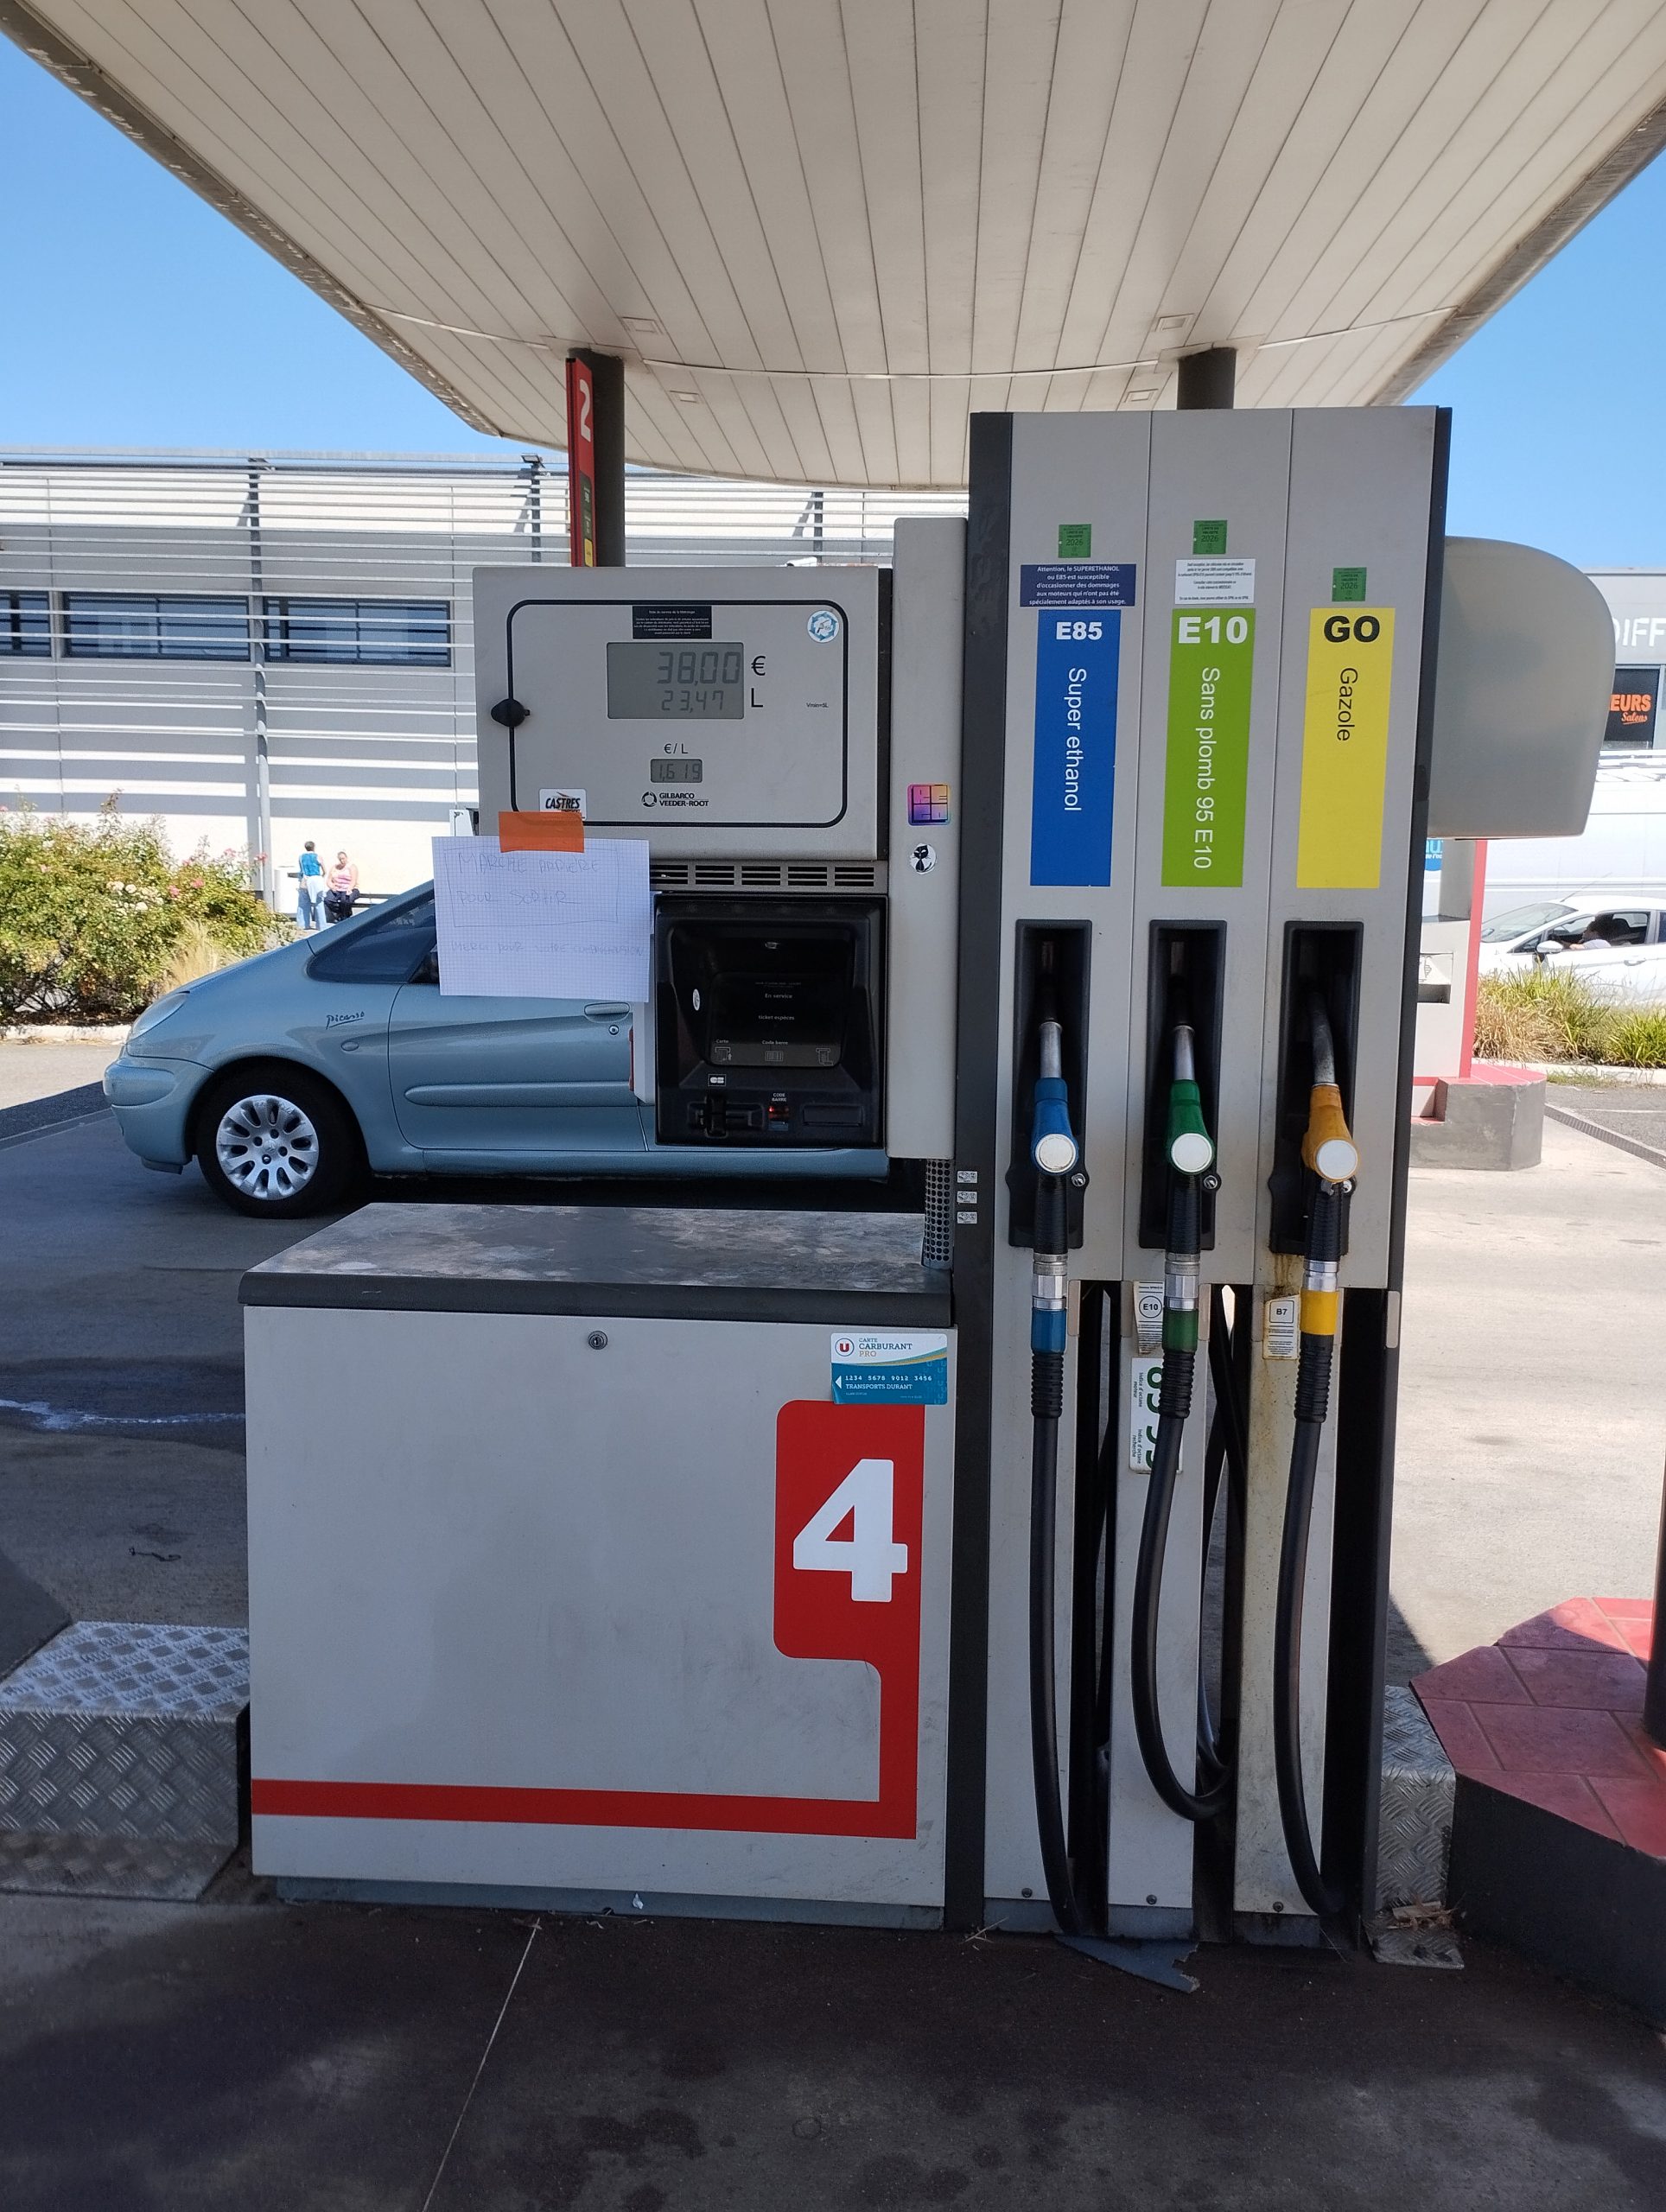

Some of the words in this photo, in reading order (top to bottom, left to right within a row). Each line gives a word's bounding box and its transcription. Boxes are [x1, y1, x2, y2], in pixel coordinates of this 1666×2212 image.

[580, 378, 591, 442] 2
[1055, 621, 1103, 641] E85
[1177, 616, 1249, 645] E10
[1323, 614, 1381, 644] GO
[751, 687, 764, 708] L
[1064, 667, 1088, 731] Super
[1199, 667, 1220, 721] Sans
[1337, 667, 1358, 741] Gazole
[1064, 735, 1084, 811] ethanol
[1195, 727, 1217, 791] plomb
[545, 798, 582, 810] CASTRES
[1194, 797, 1215, 822] 95
[1193, 829, 1213, 870] E10
[793, 1459, 908, 1602] 4
